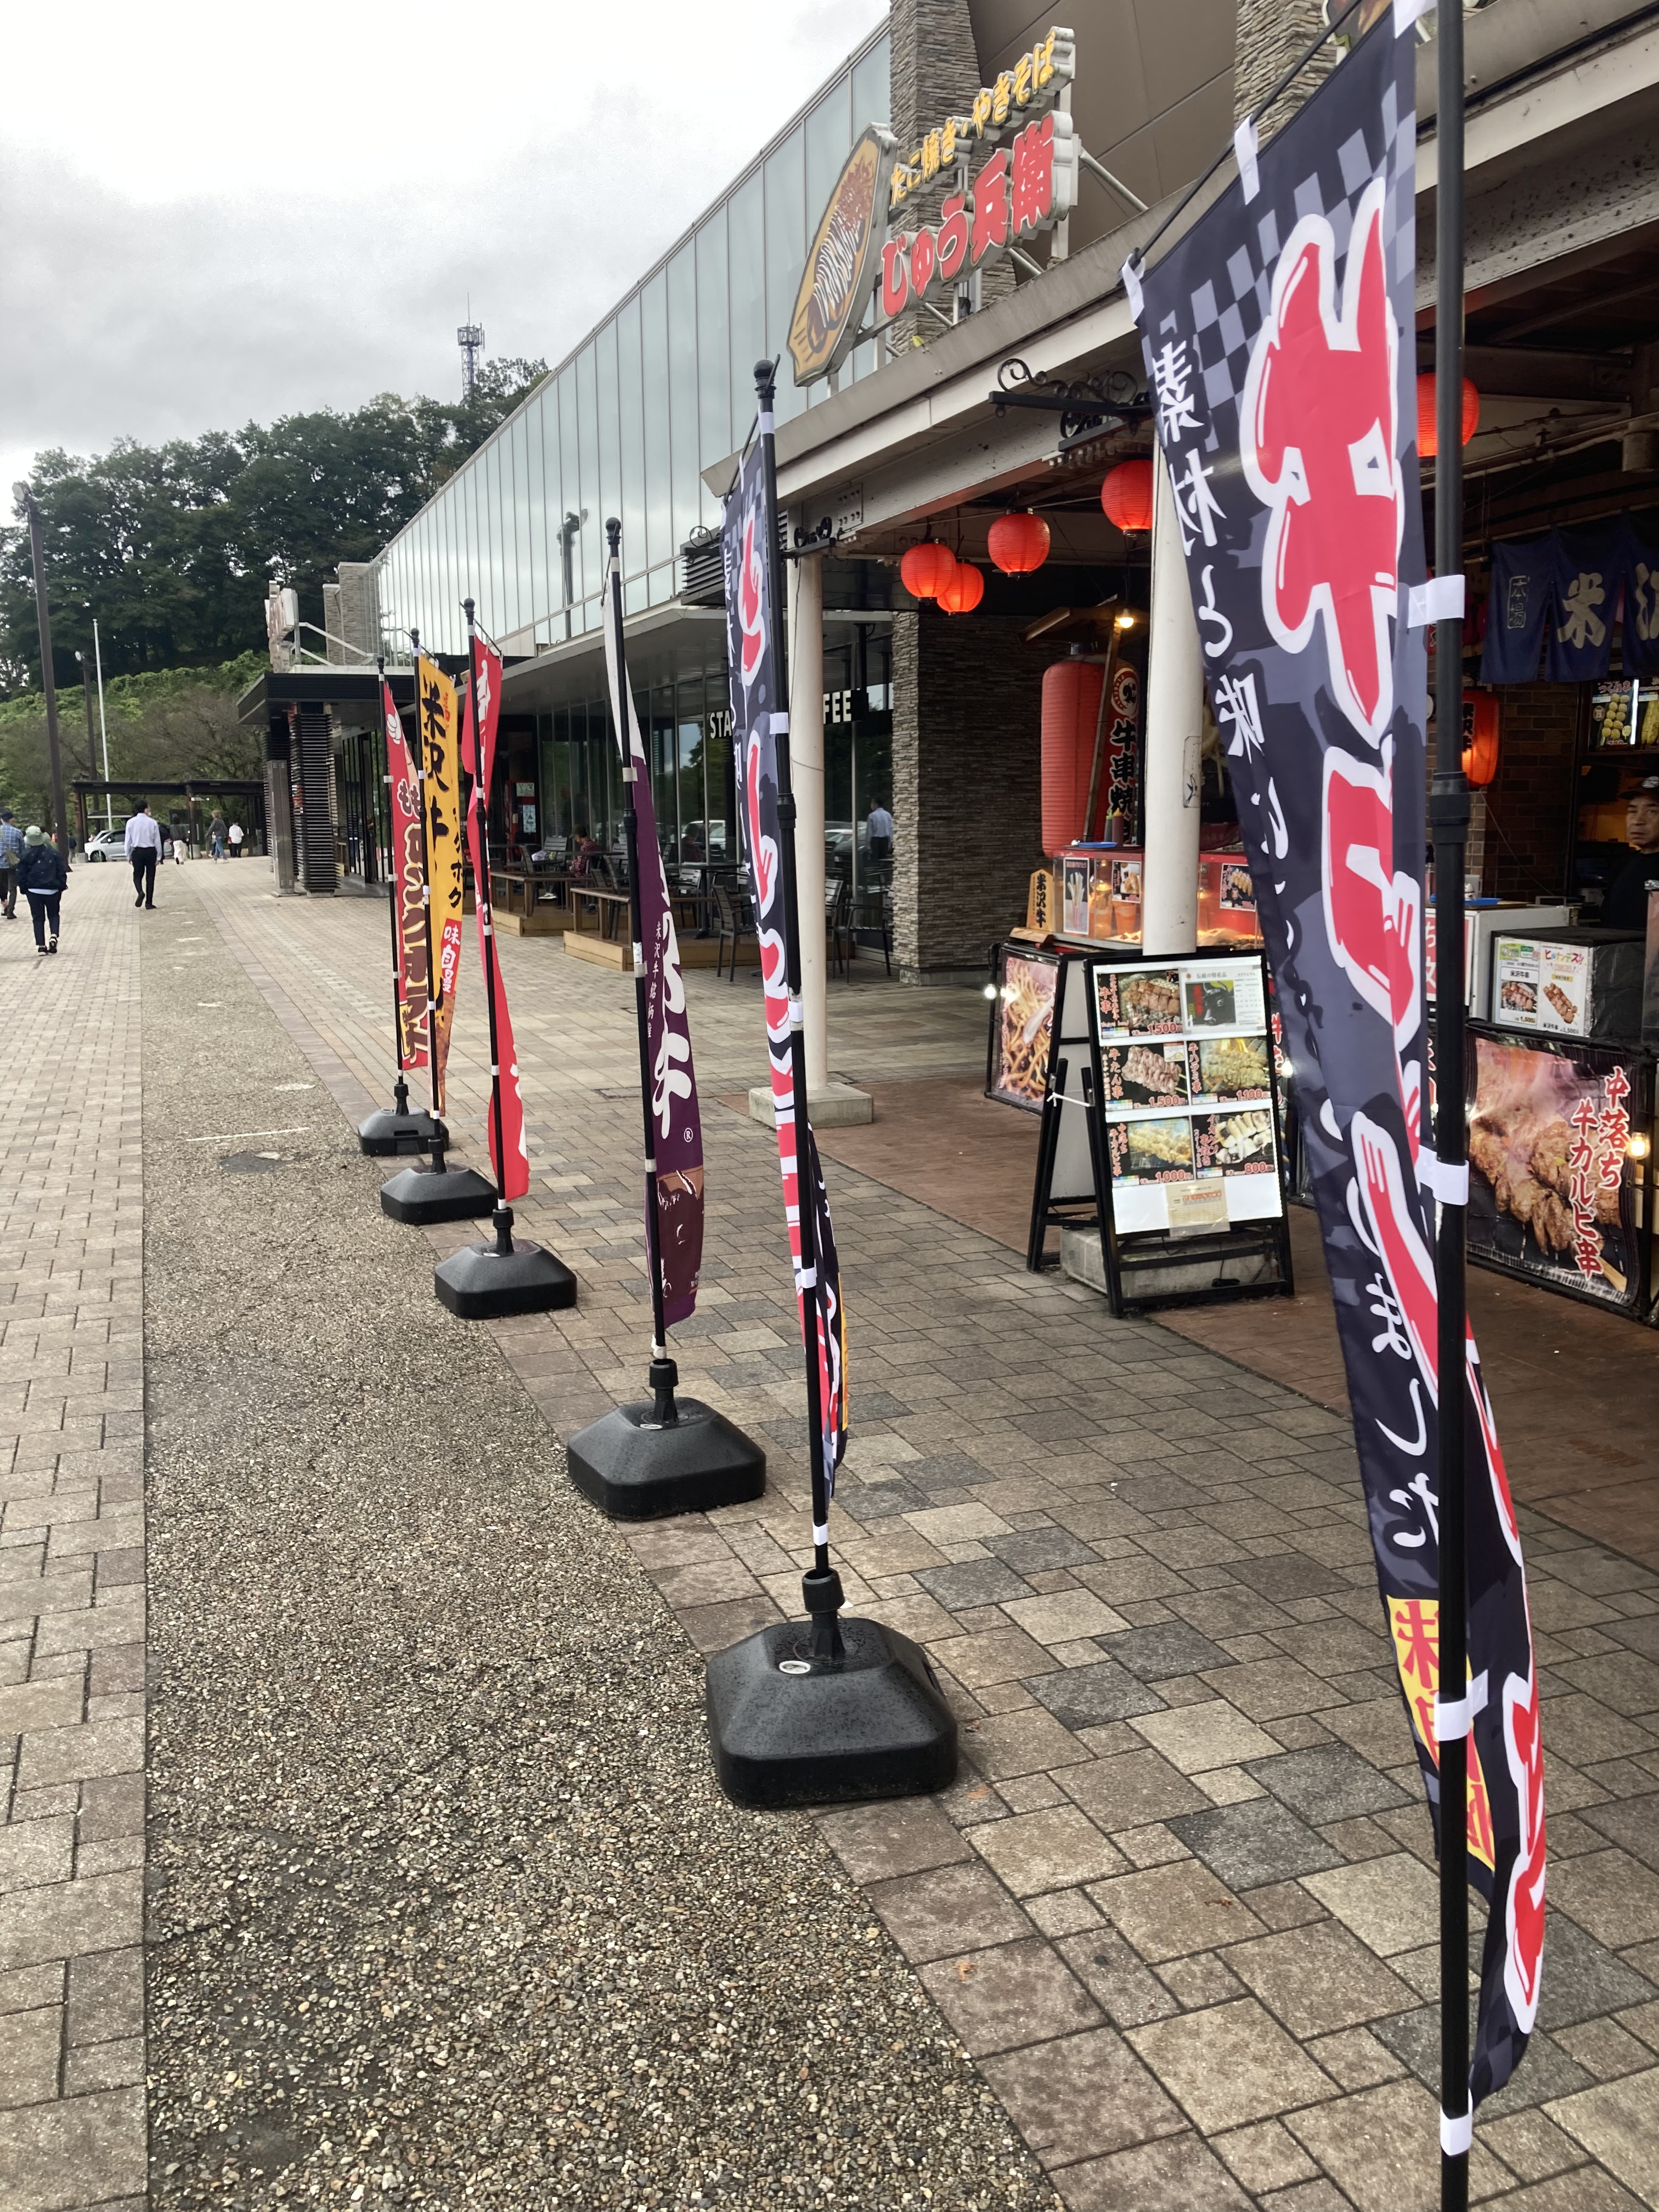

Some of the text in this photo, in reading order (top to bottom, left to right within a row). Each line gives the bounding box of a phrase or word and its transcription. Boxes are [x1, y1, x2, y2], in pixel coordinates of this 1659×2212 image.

[891, 30, 1056, 206] たこ焼き・やきそば
[882, 112, 1054, 317] じゅう兵衛
[823, 689, 852, 725] FEE
[1570, 1096, 1604, 1282] 牛カルビ串
[1598, 1064, 1633, 1192] 中落ち
